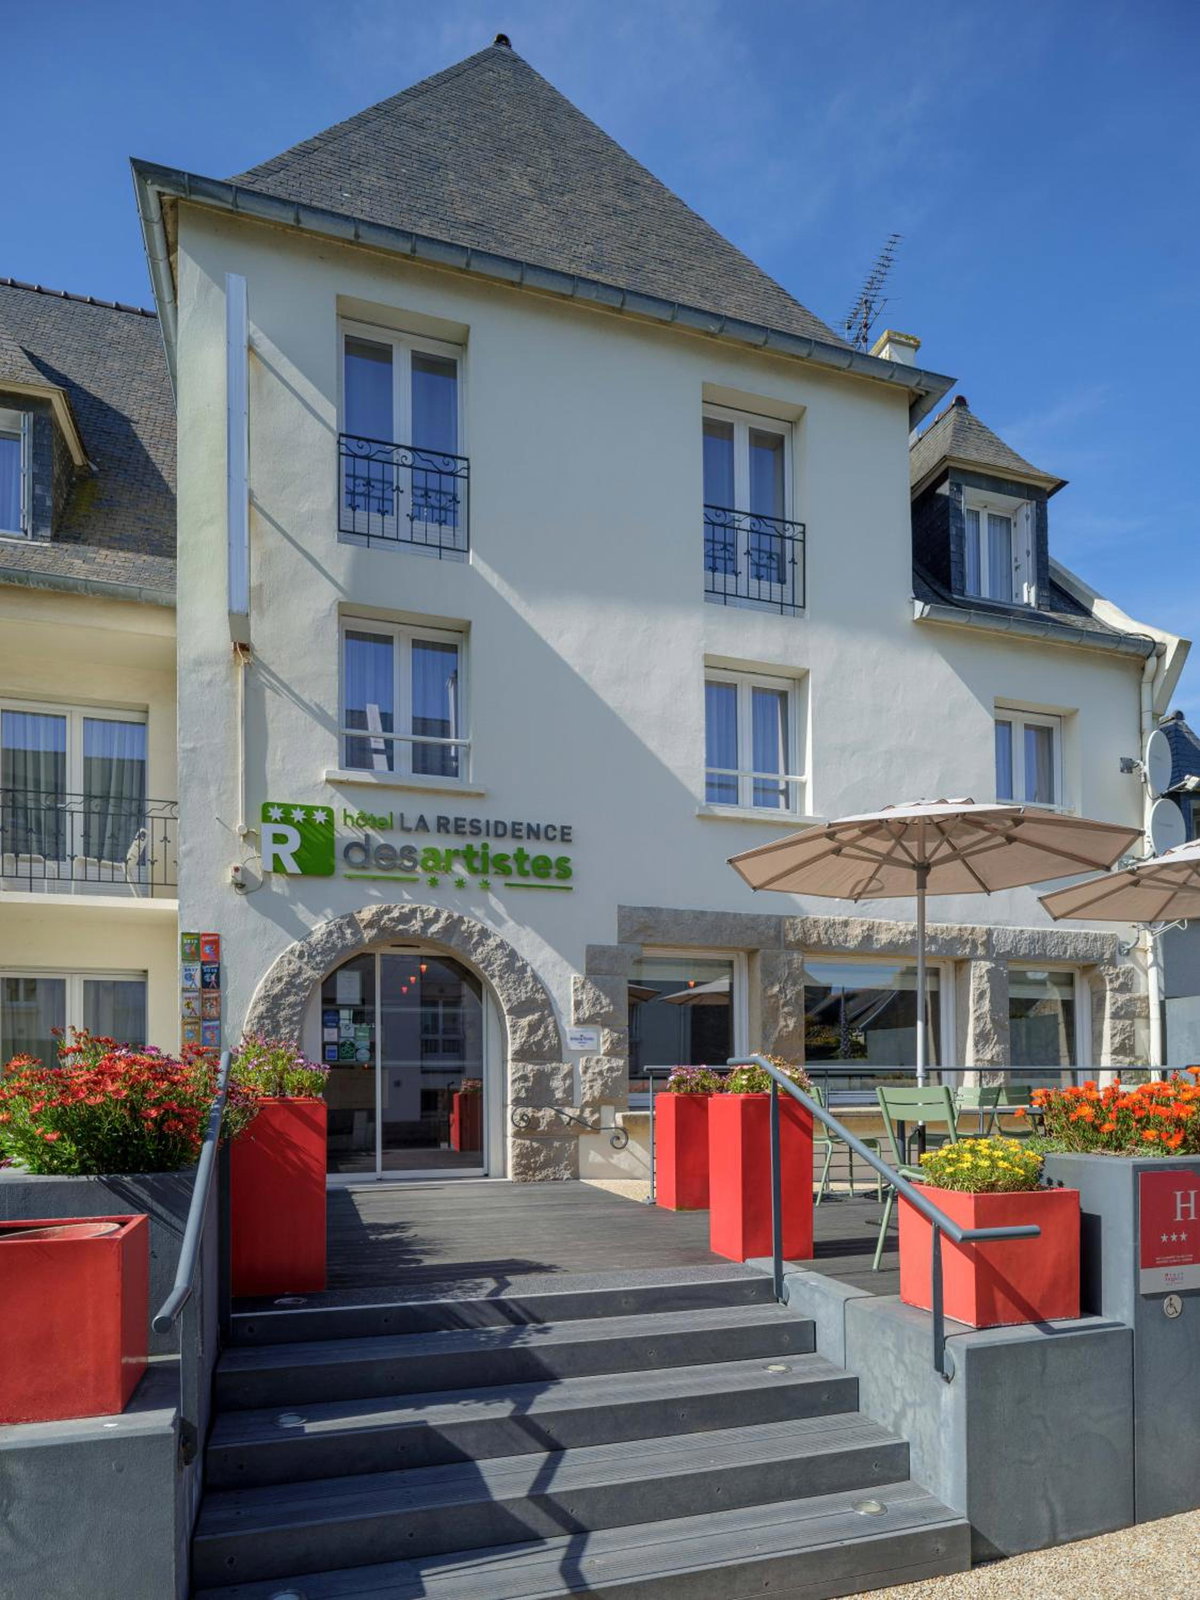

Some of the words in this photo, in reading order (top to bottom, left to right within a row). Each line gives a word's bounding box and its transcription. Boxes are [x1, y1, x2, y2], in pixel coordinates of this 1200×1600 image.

[343, 808, 394, 830] hôtel
[400, 813, 430, 833] LA
[437, 816, 573, 842] RESIDENCE
[261, 823, 302, 874] R
[1173, 1190, 1198, 1221] H
